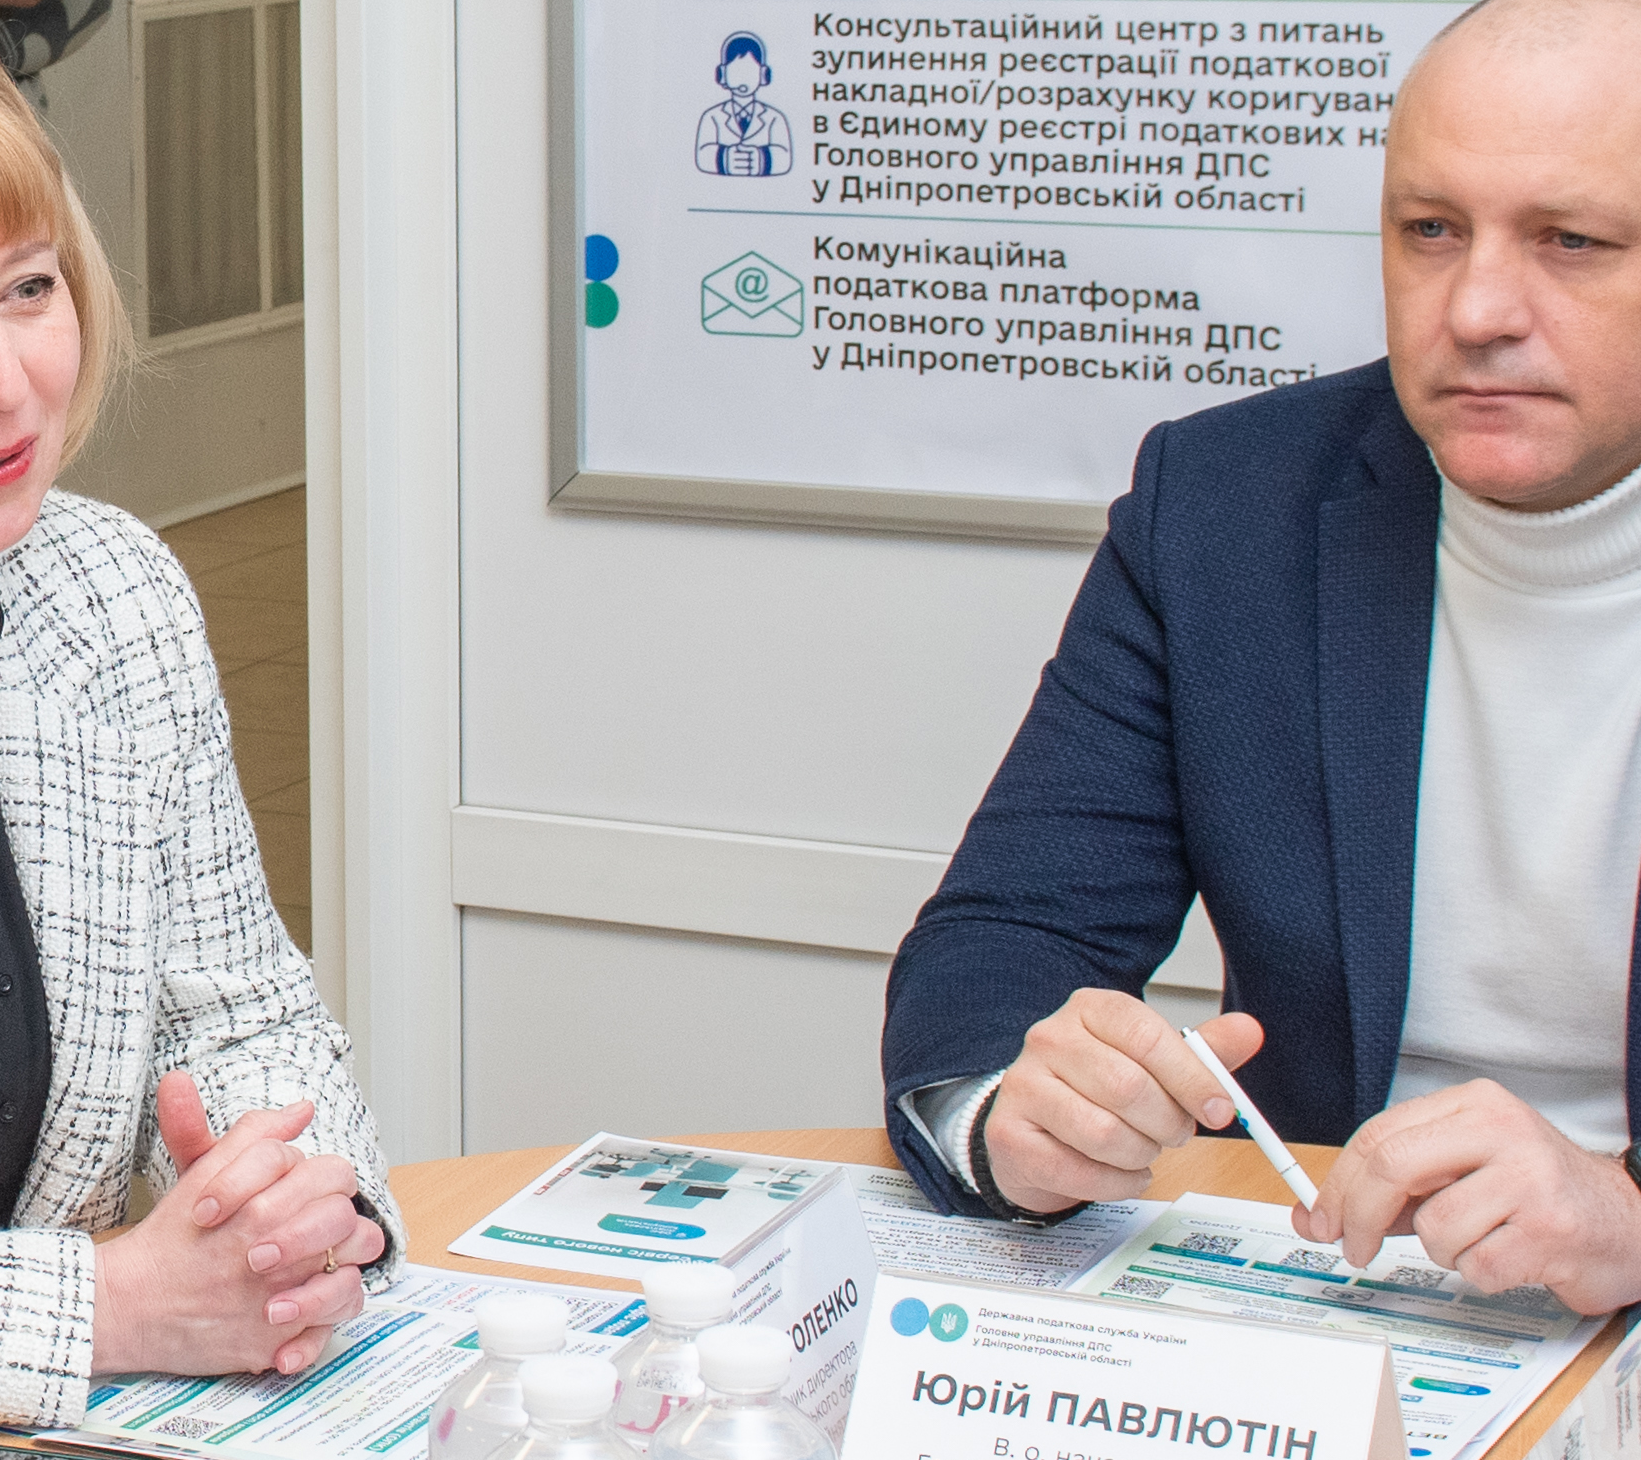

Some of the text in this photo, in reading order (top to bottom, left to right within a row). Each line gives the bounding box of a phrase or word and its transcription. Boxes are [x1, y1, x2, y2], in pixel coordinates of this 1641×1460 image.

[813, 12, 1384, 48] Консультаційний центр з питань
[811, 48, 1391, 81] зупинення реєстрації податкової
[812, 79, 1397, 119] накладної/розрахунку коригуван
[812, 110, 1344, 148] в Єдиному реєстрі податкових
[813, 236, 1068, 271] Комунікаційна
[813, 275, 1201, 315] податкова платформа
[787, 1278, 859, 1354] ОЛЕНКО
[977, 1307, 1188, 1346] Державна податкова служба України
[972, 1337, 1132, 1367] у Дніпропетровській області
[975, 1324, 1113, 1353] Головне управління ДПС
[912, 1370, 1031, 1419] Юрій
[993, 1437, 1015, 1459] В.
